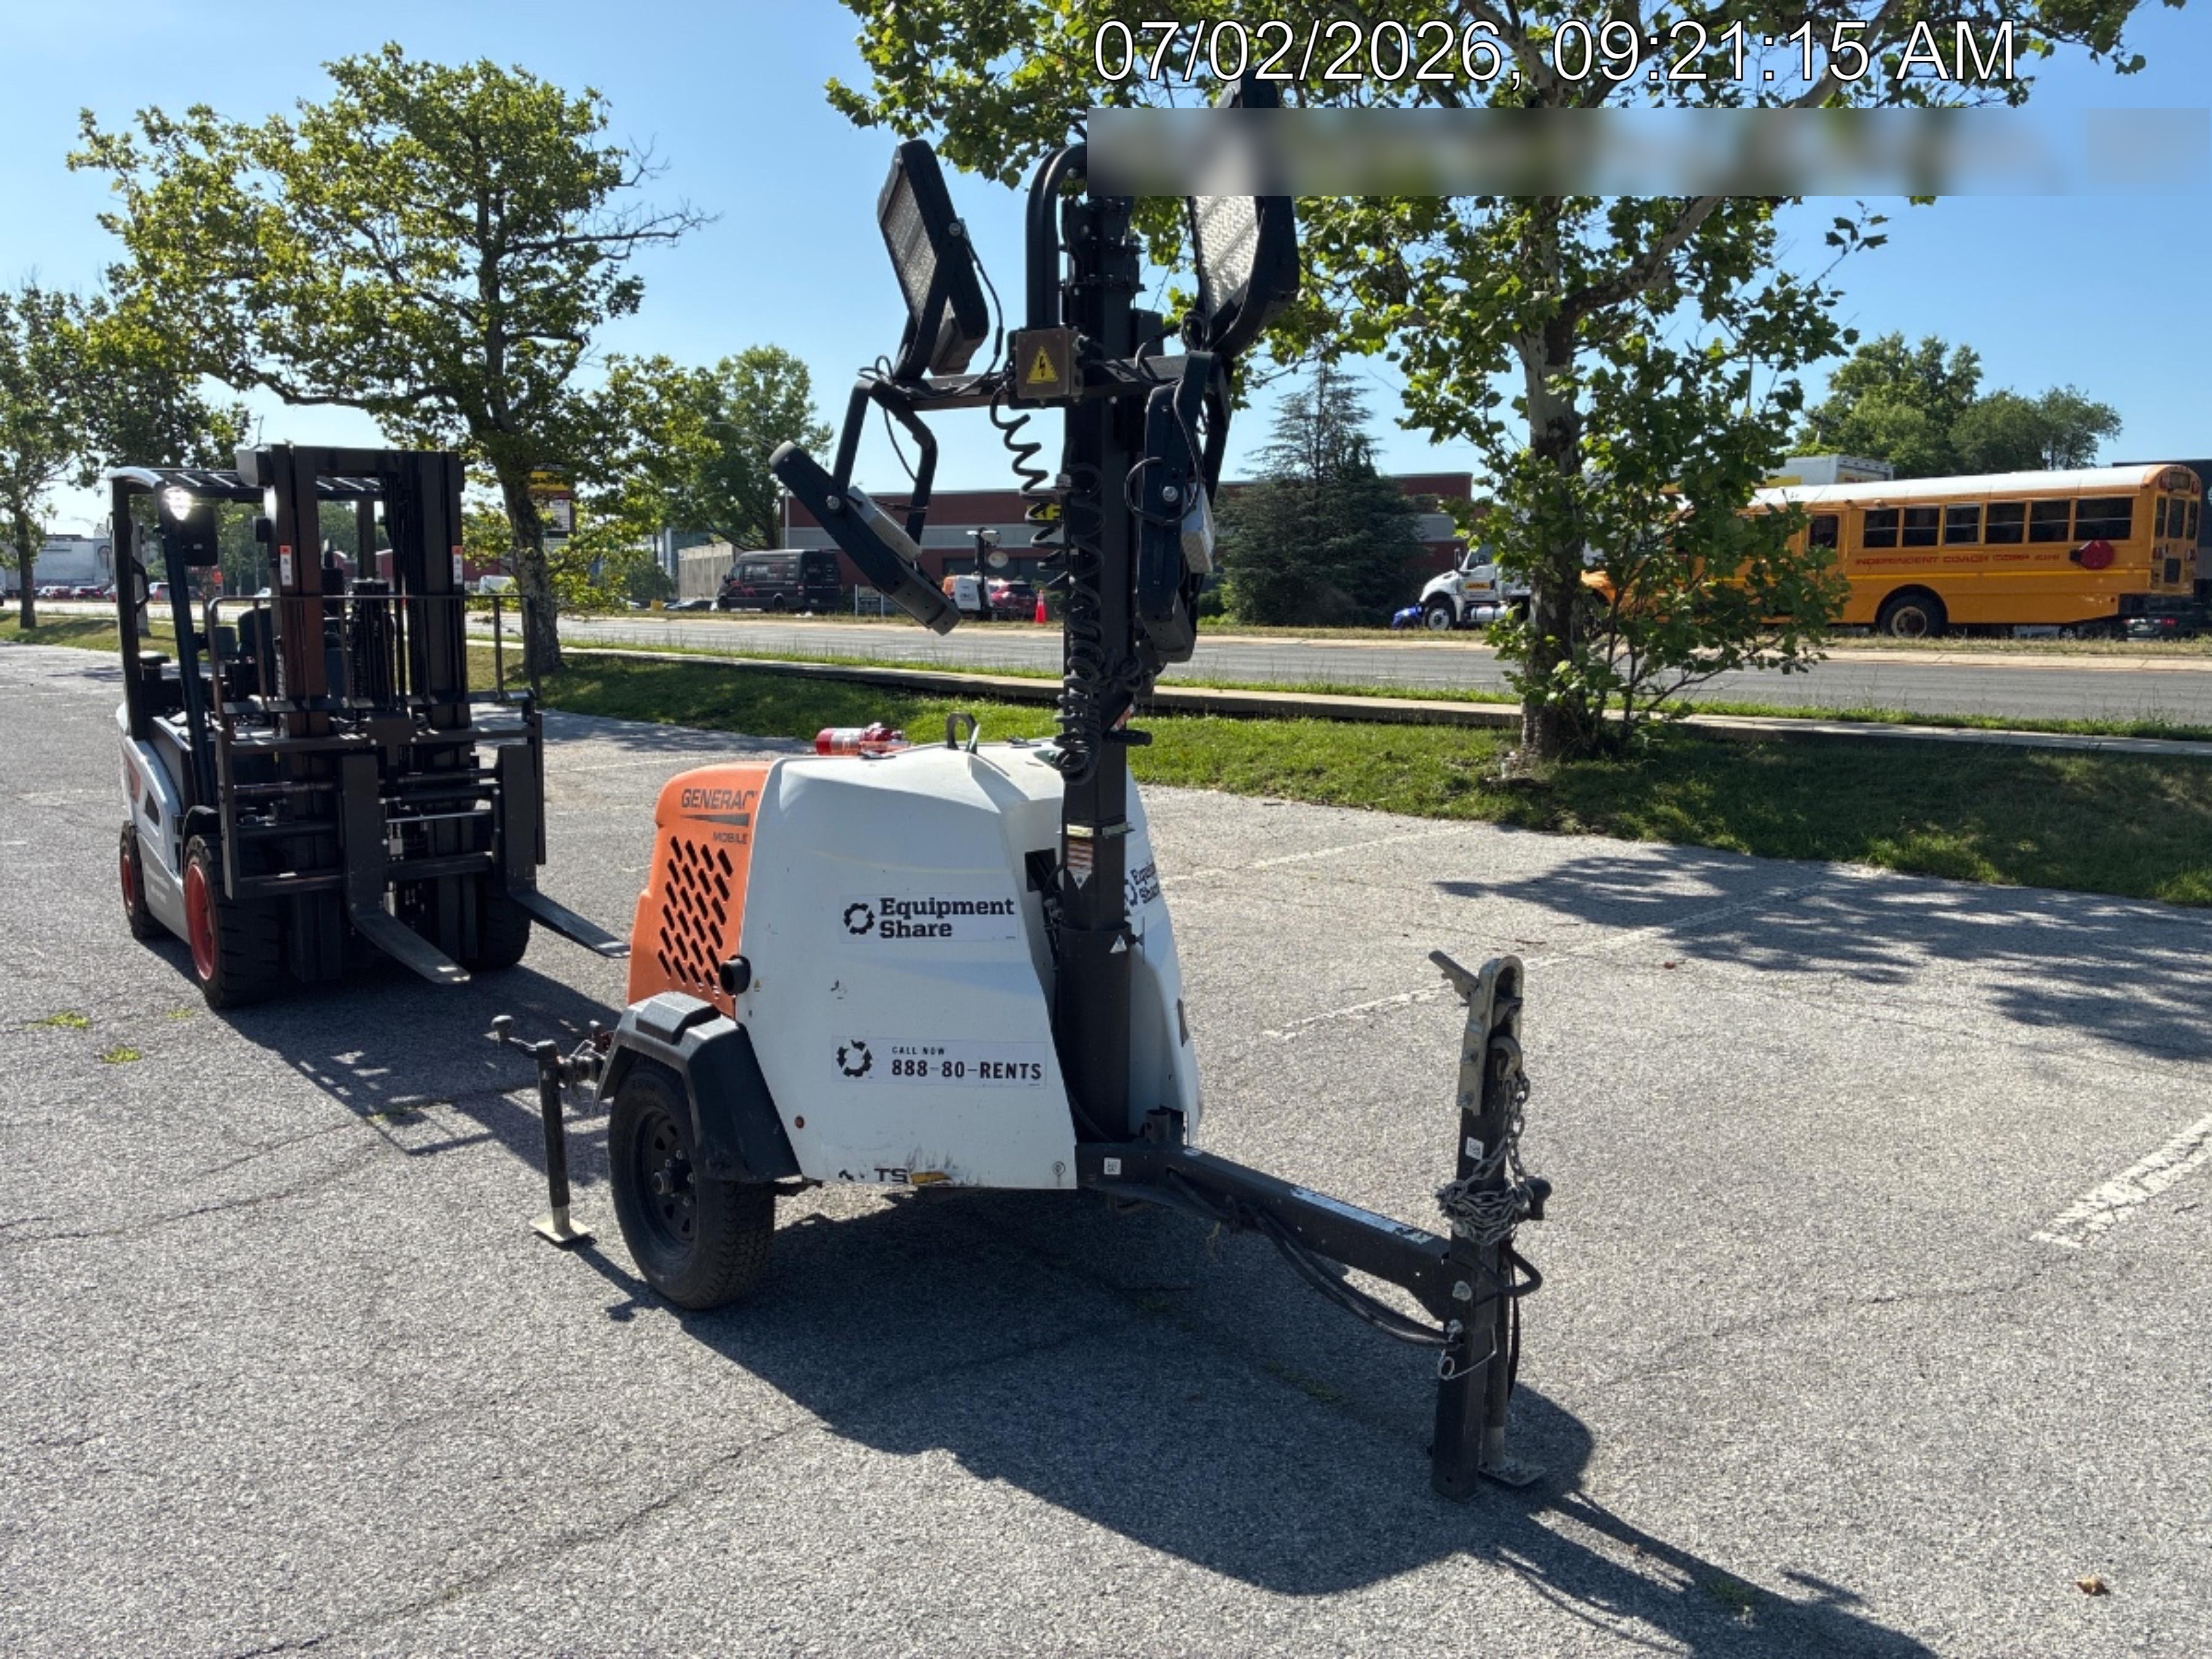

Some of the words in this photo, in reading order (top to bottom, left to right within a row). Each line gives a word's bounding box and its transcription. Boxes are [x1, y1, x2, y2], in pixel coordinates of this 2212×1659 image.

[1856, 556, 1939, 566] INDEPENDENT
[713, 831, 748, 845] MOBILE
[879, 897, 1015, 920] Equipment
[879, 919, 953, 939] Share
[892, 1046, 917, 1055] CALL
[922, 1046, 945, 1056] NOW
[892, 1059, 1041, 1080] 888-80-RENTS
